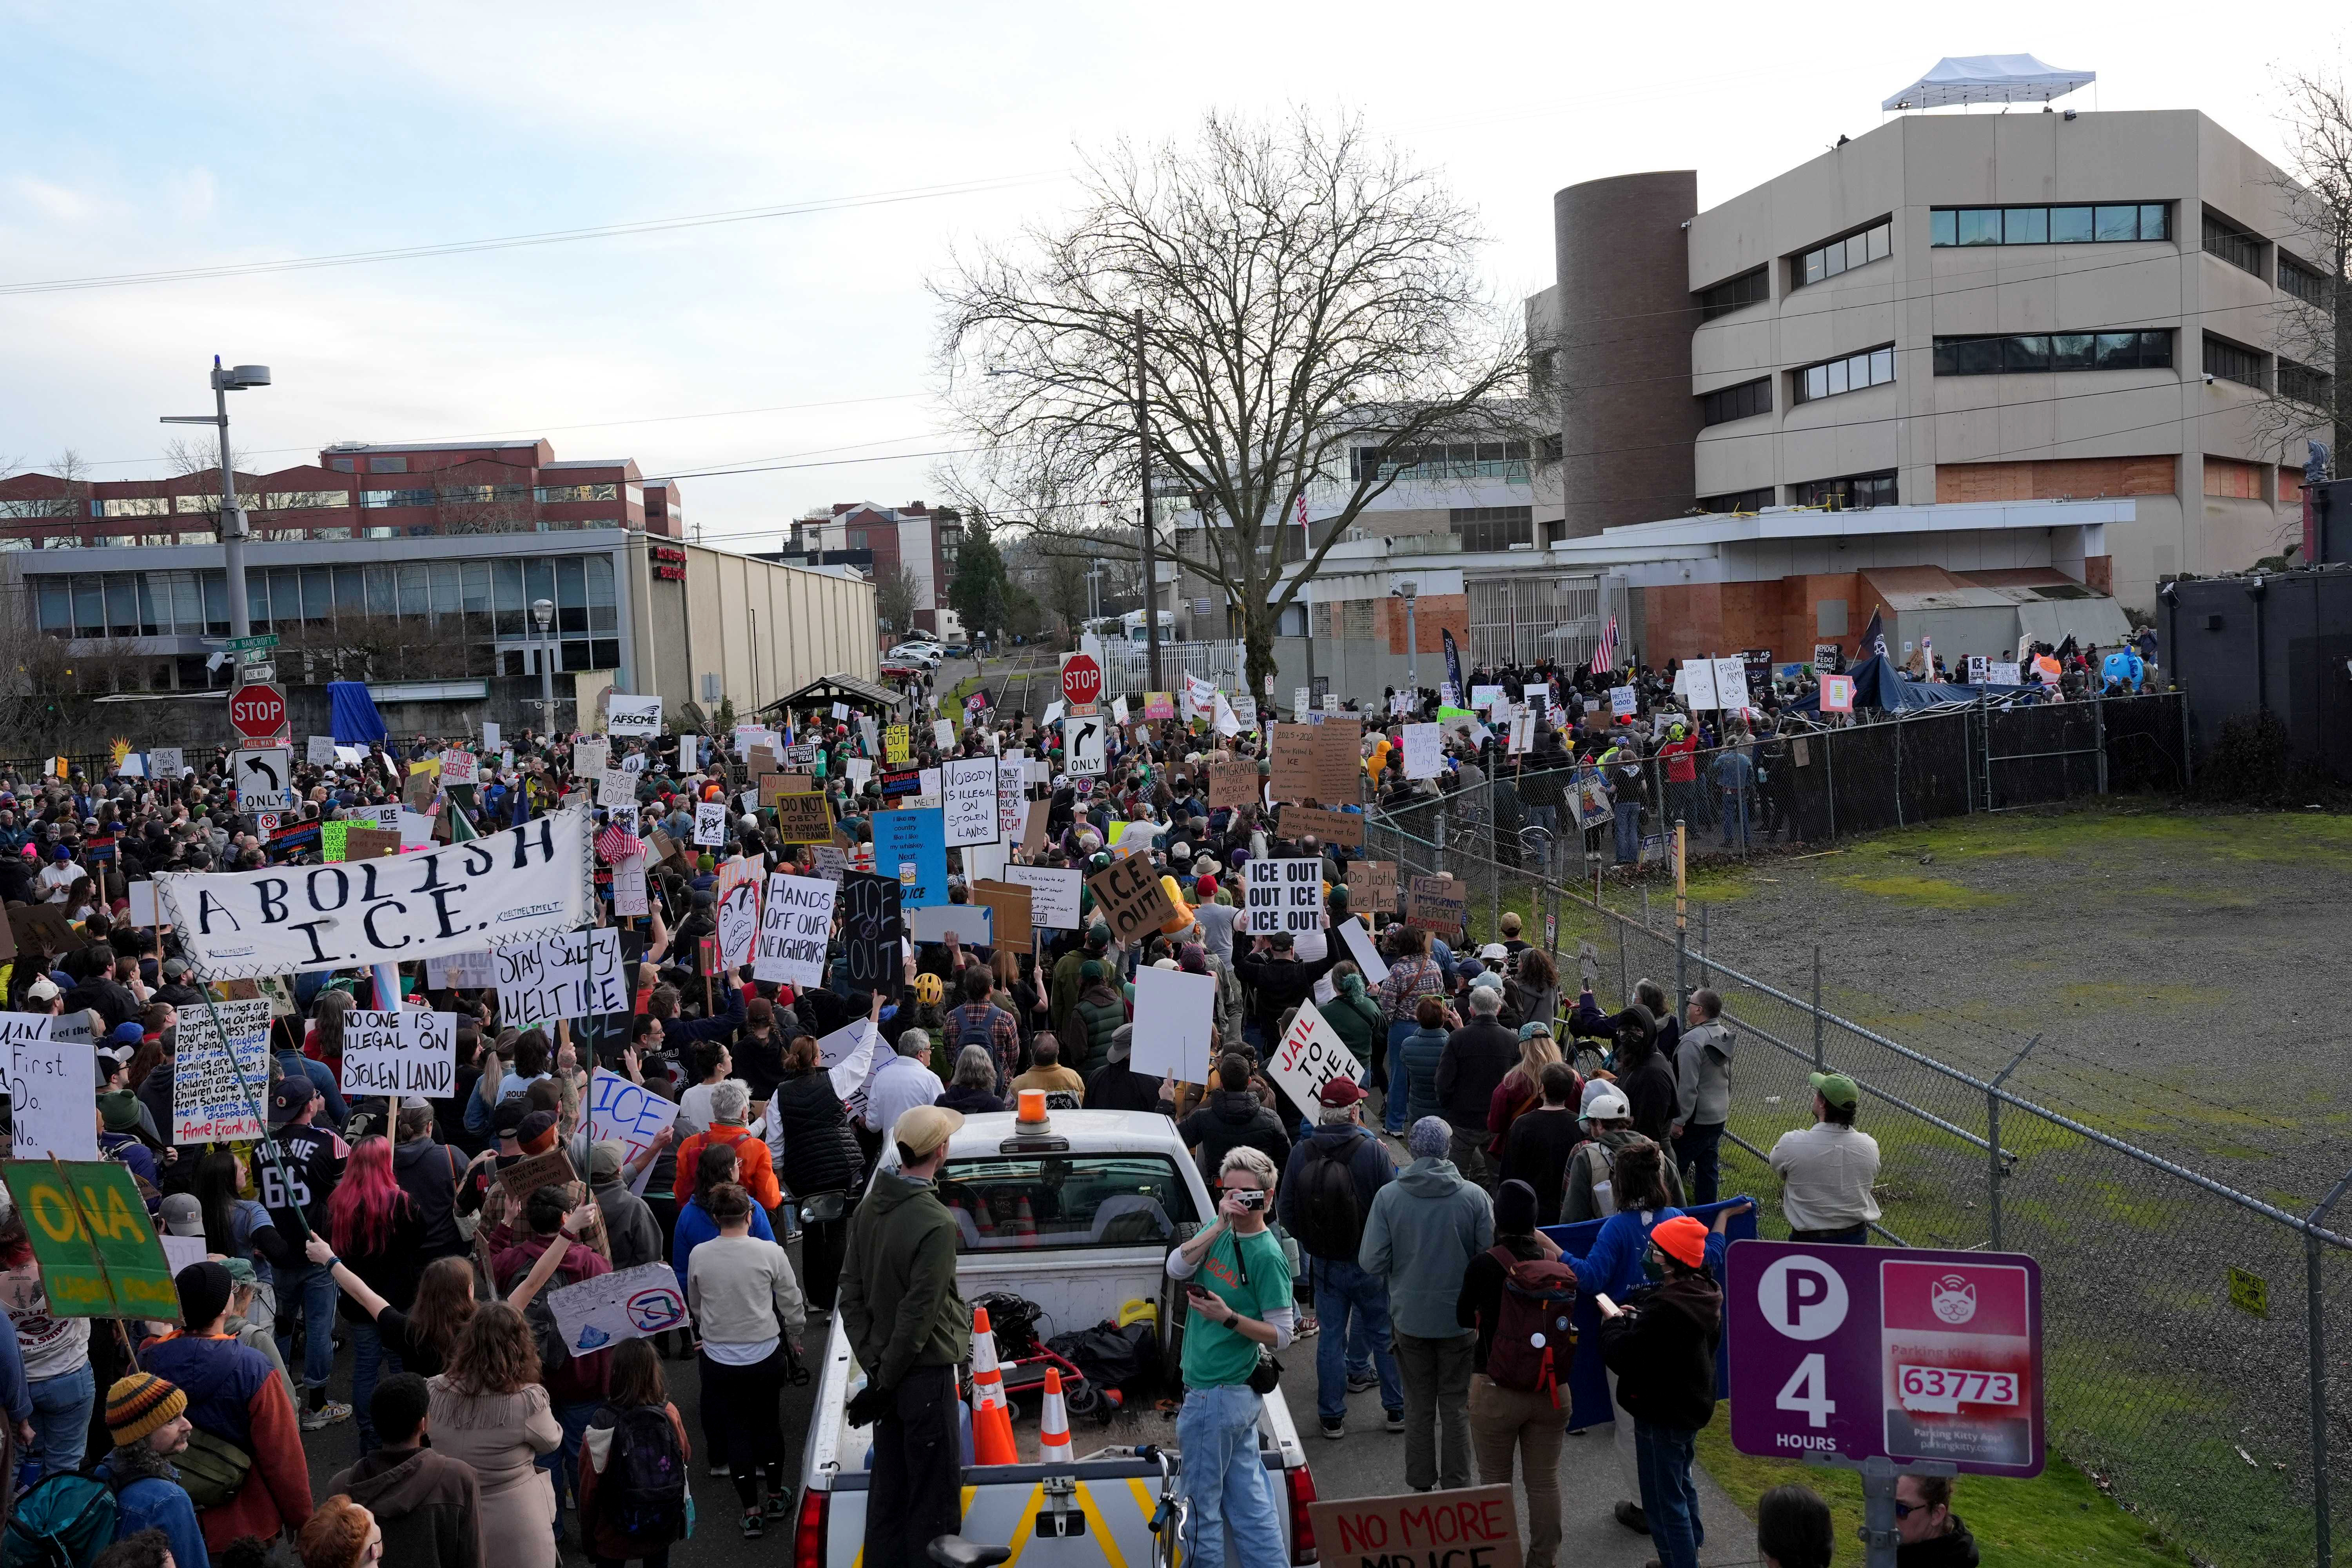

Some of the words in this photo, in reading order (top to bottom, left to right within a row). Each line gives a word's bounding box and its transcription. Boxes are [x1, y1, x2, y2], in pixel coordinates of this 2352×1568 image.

[241, 637, 271, 647] BANCROFT
[245, 652, 250, 661] SW
[251, 650, 261, 659] MOODY
[1972, 657, 1983, 670] ICE
[257, 669, 266, 677] WAY
[1719, 660, 1741, 673] FROG
[1065, 670, 1098, 690] STOP
[1727, 670, 1744, 684] ARMY
[235, 702, 281, 721] STOP
[611, 715, 657, 725] AFSCME
[887, 725, 906, 735] ICE
[1410, 724, 1425, 736] ICE
[888, 735, 906, 745] OUT
[1408, 738, 1418, 747] my
[1421, 736, 1438, 746] glass
[155, 751, 174, 760] FUCK
[887, 750, 907, 762] PDX
[1071, 758, 1100, 771] ONLY
[1211, 762, 1259, 779] IMMIGRANTS
[606, 772, 632, 789] ICE
[883, 771, 919, 783] Doctors
[889, 778, 920, 787] defending
[945, 763, 992, 787] NOBODY
[604, 789, 632, 805] OUT
[883, 784, 916, 793] democracy
[945, 791, 955, 801] IS
[959, 790, 996, 800] ILLEGAL
[1216, 785, 1250, 795] AMERICA
[246, 795, 283, 807] ONLY
[781, 798, 797, 812] DO
[801, 797, 823, 811] NOT
[915, 798, 936, 807] MELT
[962, 799, 978, 811] ON
[949, 810, 988, 826] STOLEN
[1283, 809, 1301, 819] Those
[1314, 815, 1326, 824] deny
[1328, 815, 1349, 825] Freedom
[270, 822, 319, 841] Educadores
[283, 828, 319, 842] defendiendo
[795, 823, 829, 831] ADVANCE
[797, 831, 830, 840] TYRANNY
[958, 824, 989, 838] LANDS
[199, 819, 554, 935] ABOLISH
[1252, 863, 1278, 882] ICE
[1287, 862, 1318, 882] OUT
[1349, 871, 1363, 883] Do
[614, 872, 642, 892] ICE
[1092, 860, 1151, 912] I.C.E.
[1414, 878, 1452, 894] KEEP
[770, 880, 830, 910] HANDS
[909, 887, 926, 899] ICE
[1249, 887, 1281, 907] OUT
[1290, 887, 1316, 906] ICE
[1350, 891, 1368, 906] Love
[1372, 889, 1396, 912] Mercy
[1414, 894, 1463, 909] IMMIGRANTS
[615, 893, 648, 913] Please
[846, 879, 896, 931] ICE
[1118, 886, 1163, 933] OUT!
[766, 908, 794, 931] OFF
[797, 913, 828, 936] OUR
[1252, 911, 1278, 930] ICE
[1287, 911, 1319, 930] OUT
[1417, 906, 1458, 921] DEPORT
[288, 884, 487, 965] I.C.E.
[1407, 916, 1461, 933] PEDOPHILES
[759, 935, 827, 964] NEIGHBORS
[496, 942, 545, 985] STAY
[850, 940, 898, 981] OUT
[223, 1002, 251, 1015] things
[253, 1002, 270, 1012] are
[505, 983, 568, 1025] MELT
[233, 1011, 270, 1024] outside.
[345, 1012, 361, 1027] NO
[366, 1012, 399, 1028] ONE
[415, 1013, 434, 1030] IS
[345, 1031, 408, 1051] ILLEGAL
[419, 1028, 448, 1051] ON
[1281, 1018, 1315, 1072] JAIL
[13, 1044, 67, 1076] First.
[1298, 1042, 1322, 1077] TO
[344, 1054, 399, 1090] STOLEN
[407, 1060, 450, 1093] LAND.
[13, 1078, 41, 1112] Do.
[590, 1076, 668, 1136] ICE
[13, 1120, 38, 1145] No.
[29, 1183, 145, 1244] ONA
[1786, 1269, 1828, 1326] P
[1776, 1353, 1835, 1428] 4
[1903, 1368, 2013, 1403] 63773
[1776, 1433, 1837, 1452] HOURS
[1914, 1428, 1951, 1444] Parking
[1953, 1429, 1978, 1443] Kitty
[1338, 1508, 1388, 1554] NO
[1399, 1500, 1509, 1550] MORE
